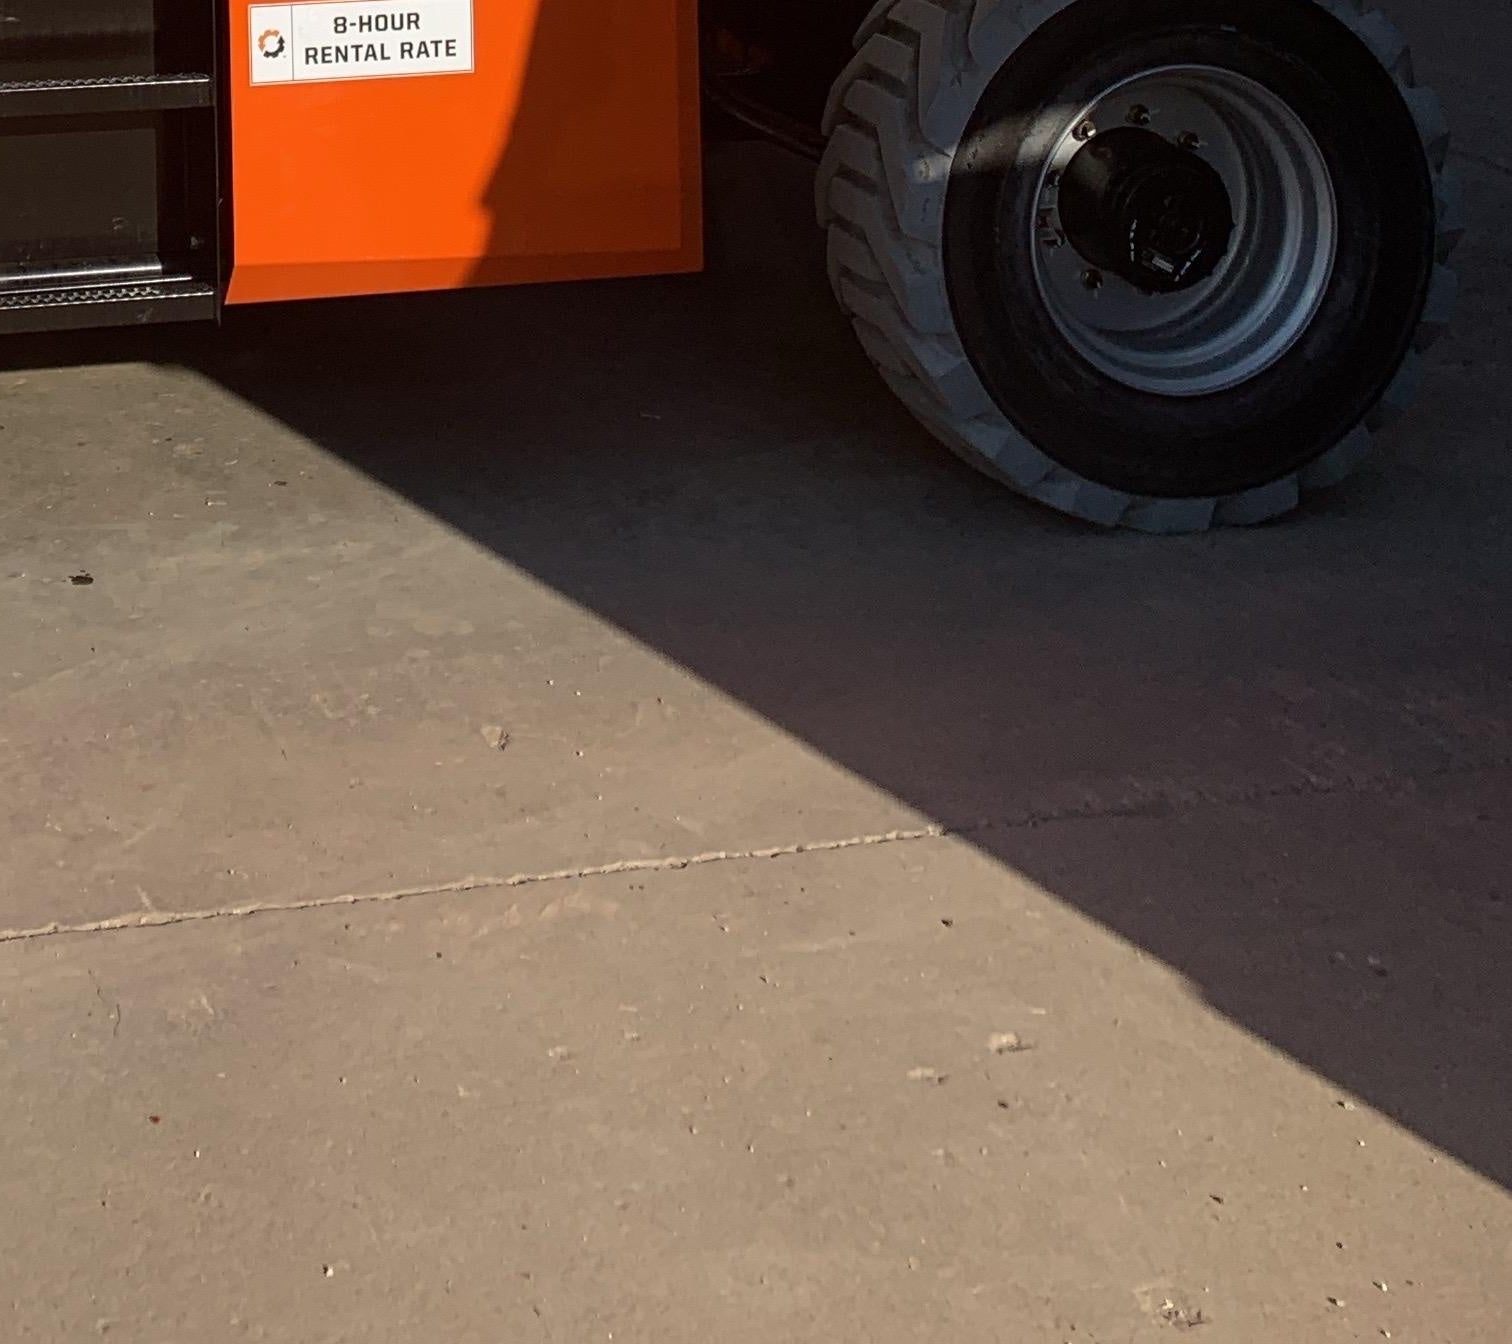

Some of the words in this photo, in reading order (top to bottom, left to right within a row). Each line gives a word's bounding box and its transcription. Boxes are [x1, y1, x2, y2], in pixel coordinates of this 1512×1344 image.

[333, 12, 421, 34] 8-HOUR
[304, 43, 391, 65] RENTAL
[400, 39, 457, 60] RATE
